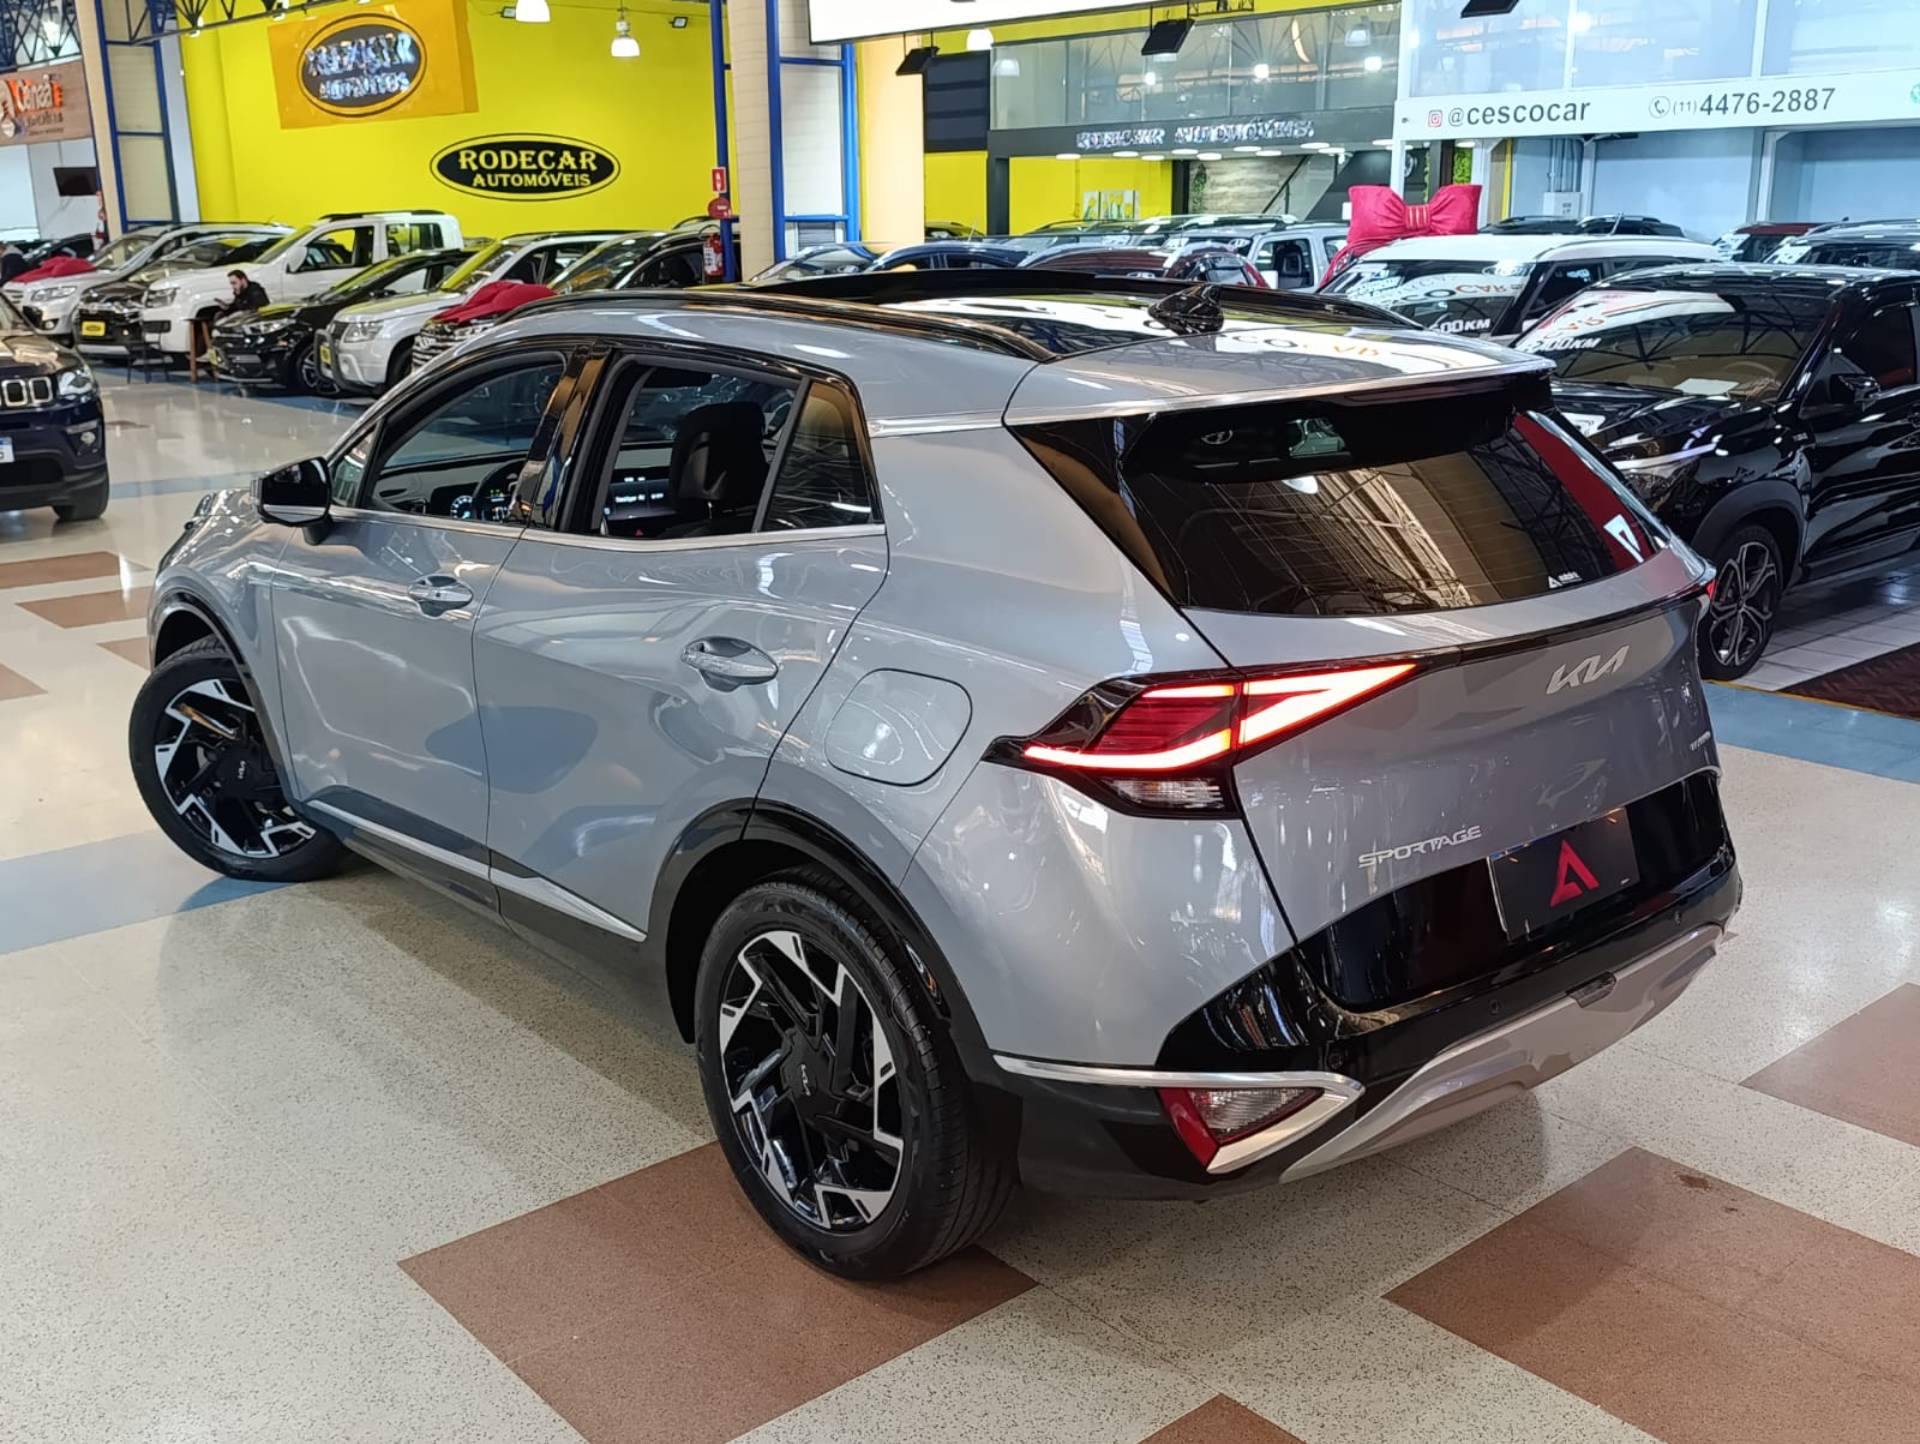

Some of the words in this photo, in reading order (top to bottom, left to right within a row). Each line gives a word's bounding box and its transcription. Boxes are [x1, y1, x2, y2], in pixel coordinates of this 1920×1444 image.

[1447, 101, 1592, 128] @cescocar
[1699, 87, 1836, 117] 4476-2887
[458, 149, 598, 172] RODECAR
[471, 170, 592, 188] AUTOMÓVEIS
[1546, 644, 1630, 695] KIA
[1358, 825, 1483, 869] SPORTAGE
